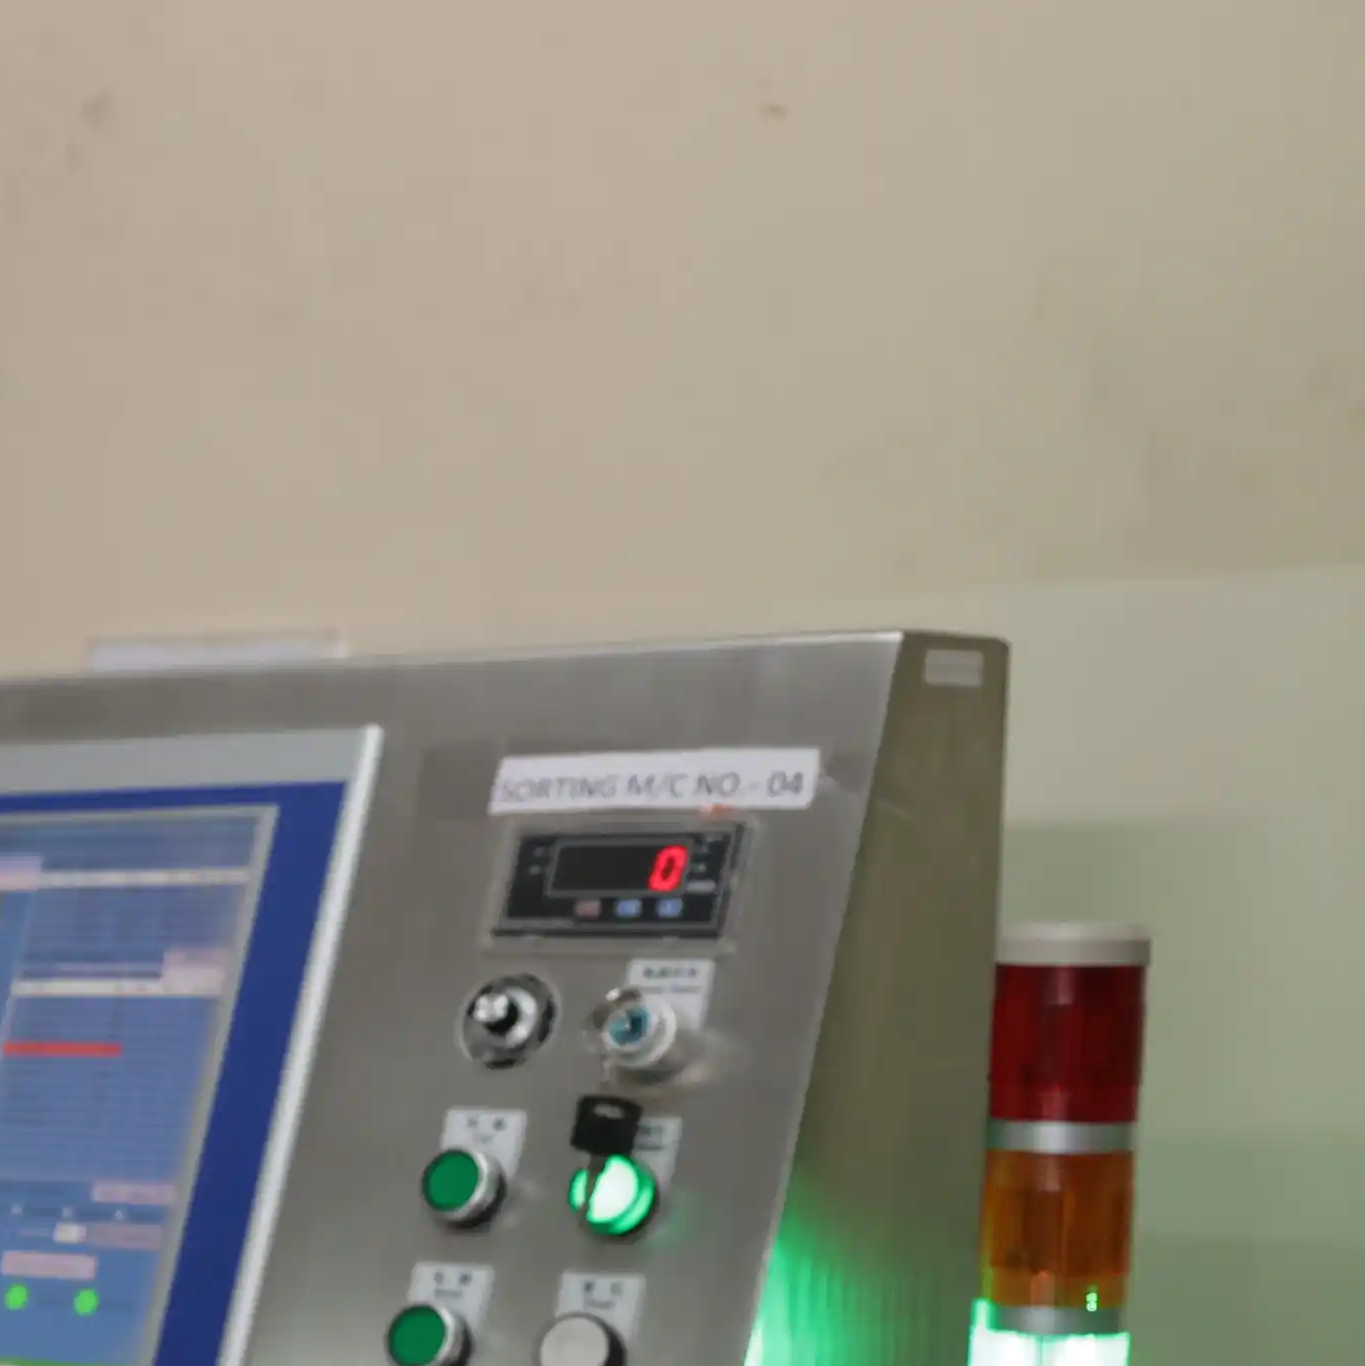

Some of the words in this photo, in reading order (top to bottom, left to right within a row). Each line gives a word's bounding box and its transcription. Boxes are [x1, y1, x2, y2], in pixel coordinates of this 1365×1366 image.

[500, 774, 616, 802] SORTING
[766, 771, 805, 798] 04
[647, 844, 688, 892] 0
